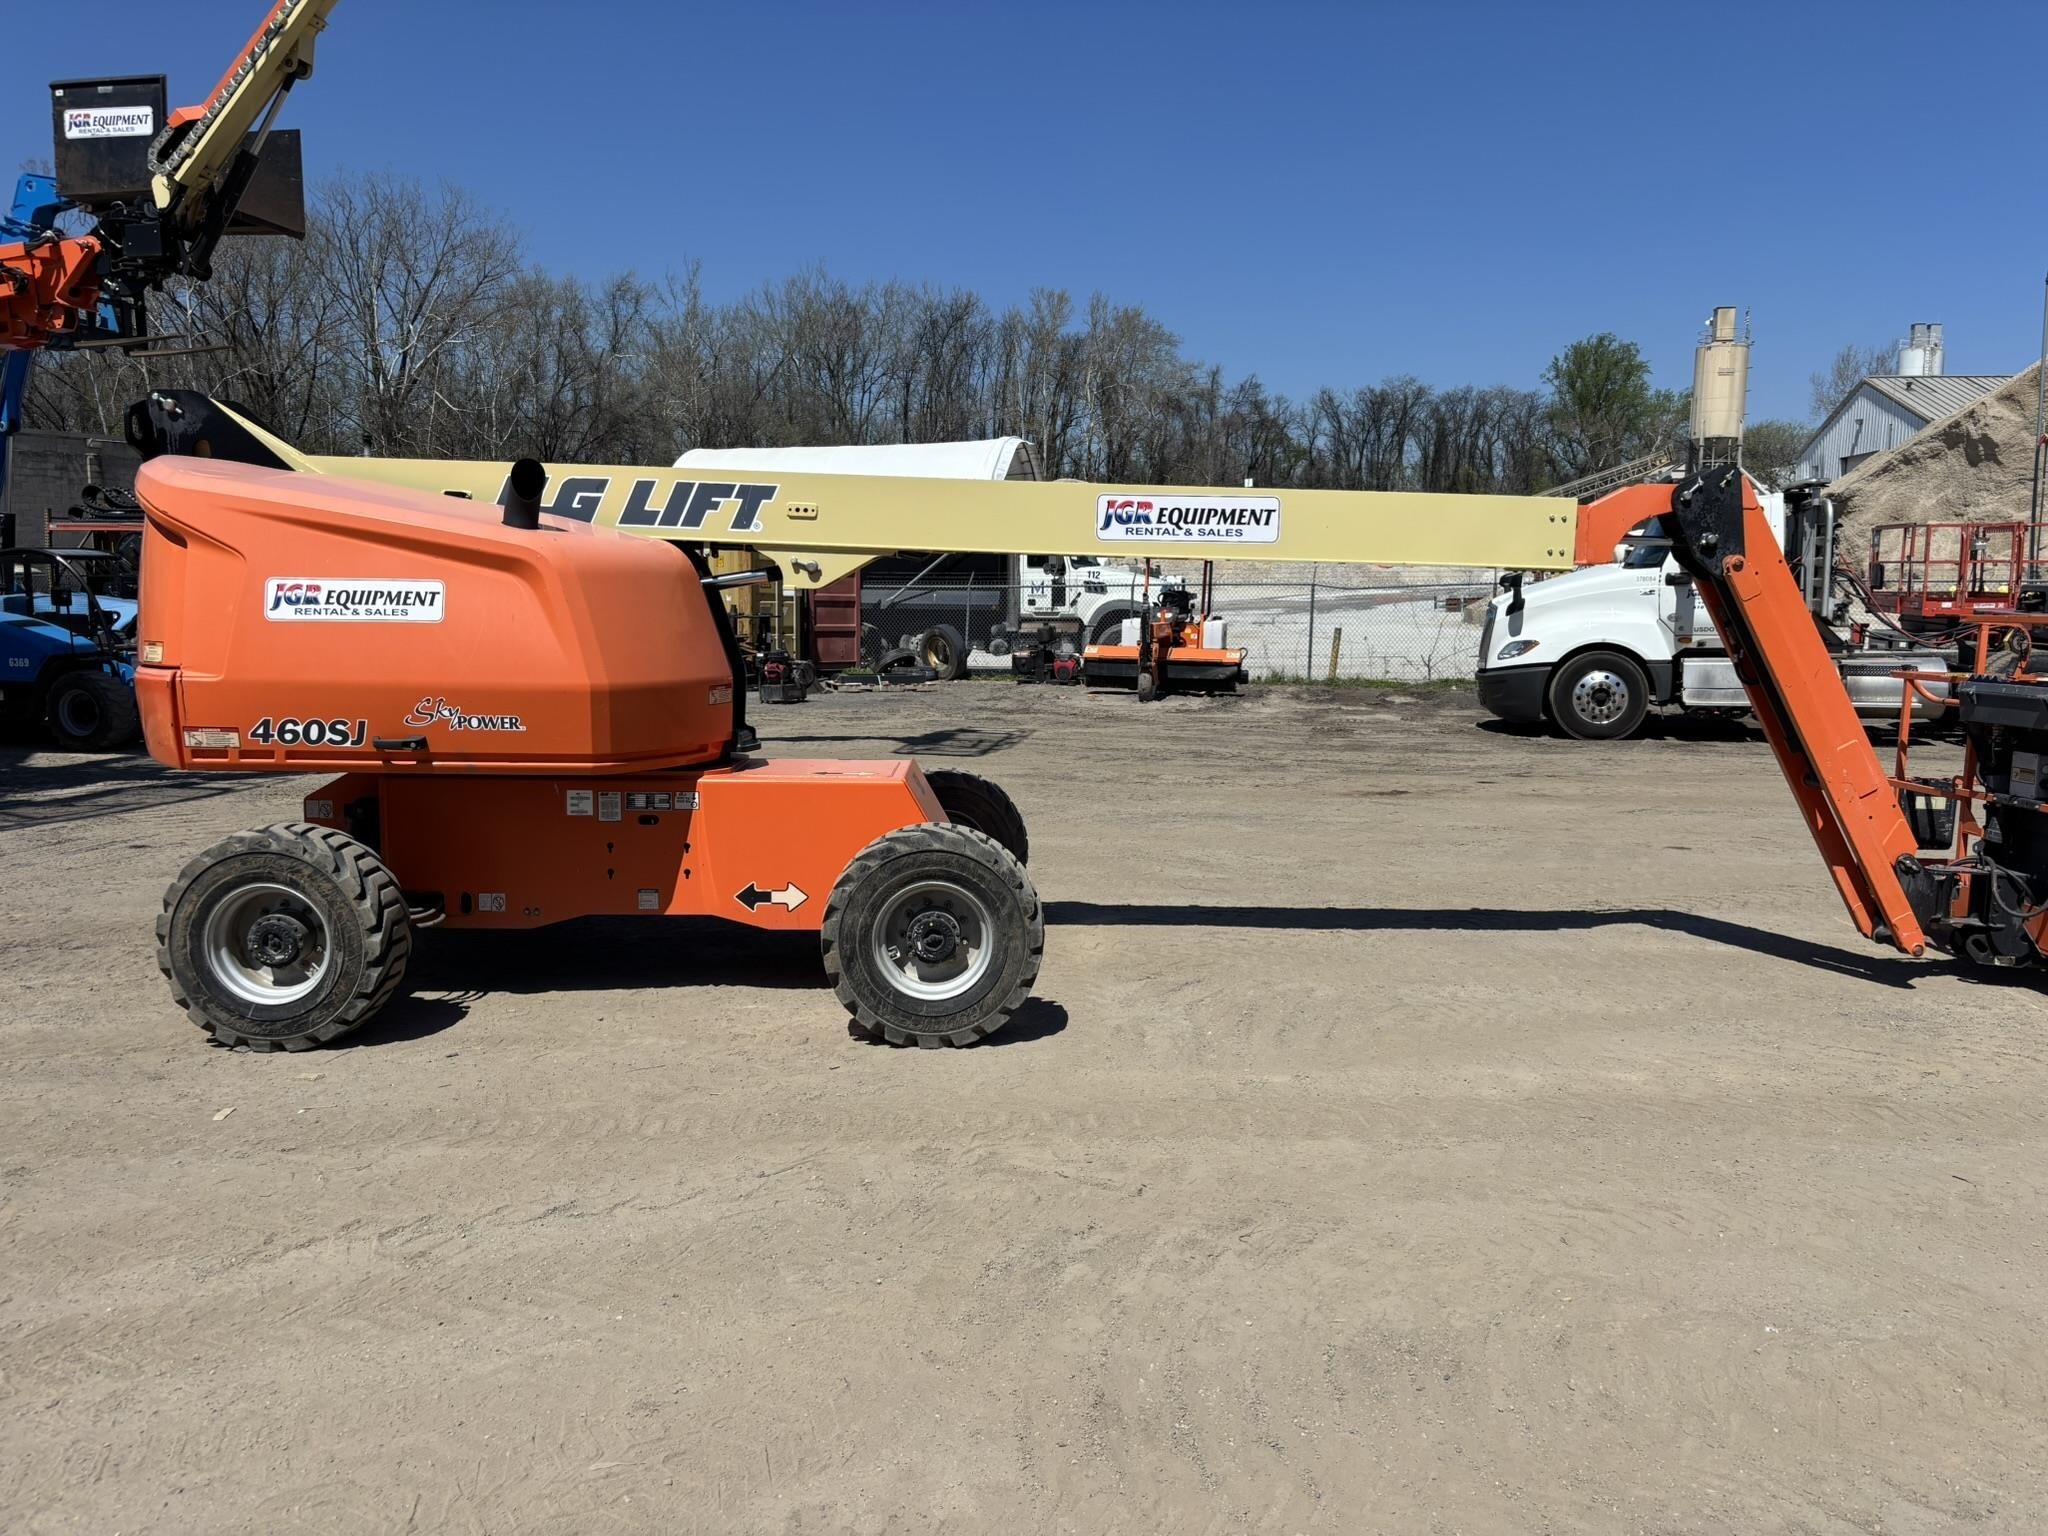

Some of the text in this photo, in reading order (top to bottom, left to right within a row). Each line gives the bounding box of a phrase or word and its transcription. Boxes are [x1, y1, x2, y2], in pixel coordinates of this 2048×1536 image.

[67, 113, 151, 132] JGR EQUIPMENT
[616, 478, 780, 532] LIFT
[1099, 499, 1277, 531] JGR EQUIPMENT
[1125, 527, 1244, 537] RENTAL & SALES
[1087, 571, 1101, 579] 112
[269, 583, 441, 611] JGR EQUIPMENT
[294, 607, 409, 617] RENTAL & SALES
[248, 716, 368, 748] 460SJ
